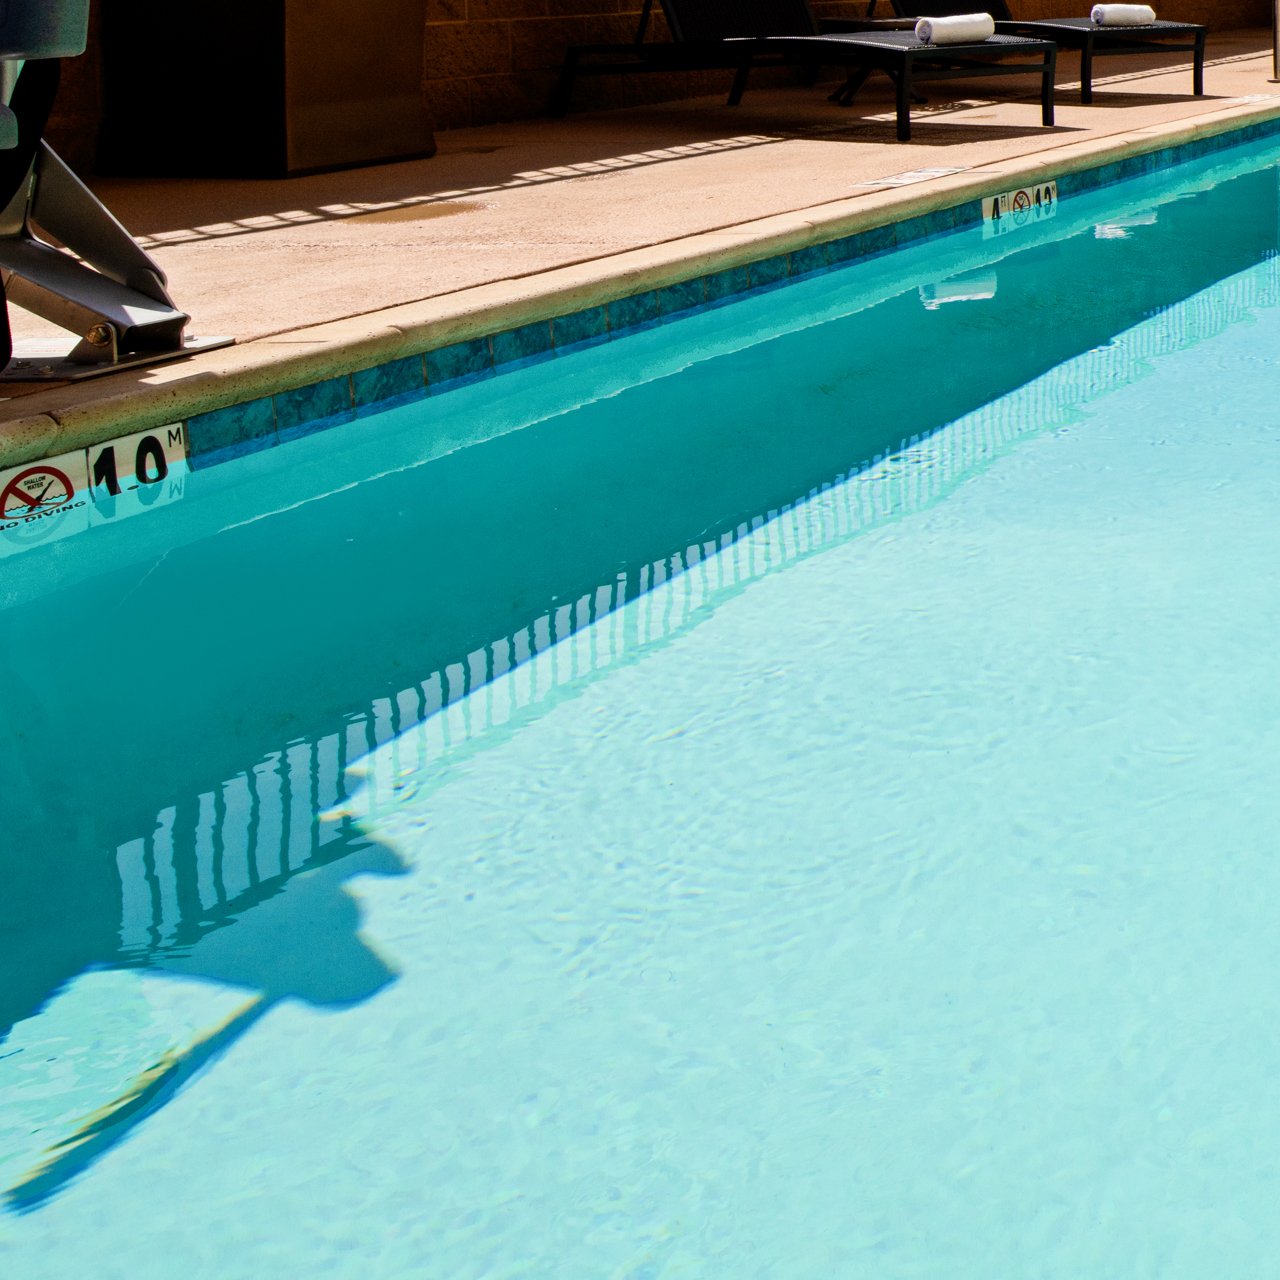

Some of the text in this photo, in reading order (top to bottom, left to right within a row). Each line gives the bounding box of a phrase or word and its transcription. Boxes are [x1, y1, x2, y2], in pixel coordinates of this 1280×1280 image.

[167, 427, 182, 447] M
[23, 475, 46, 486] SHALLOW
[26, 481, 44, 491] WATER
[25, 500, 86, 523] DIVING
